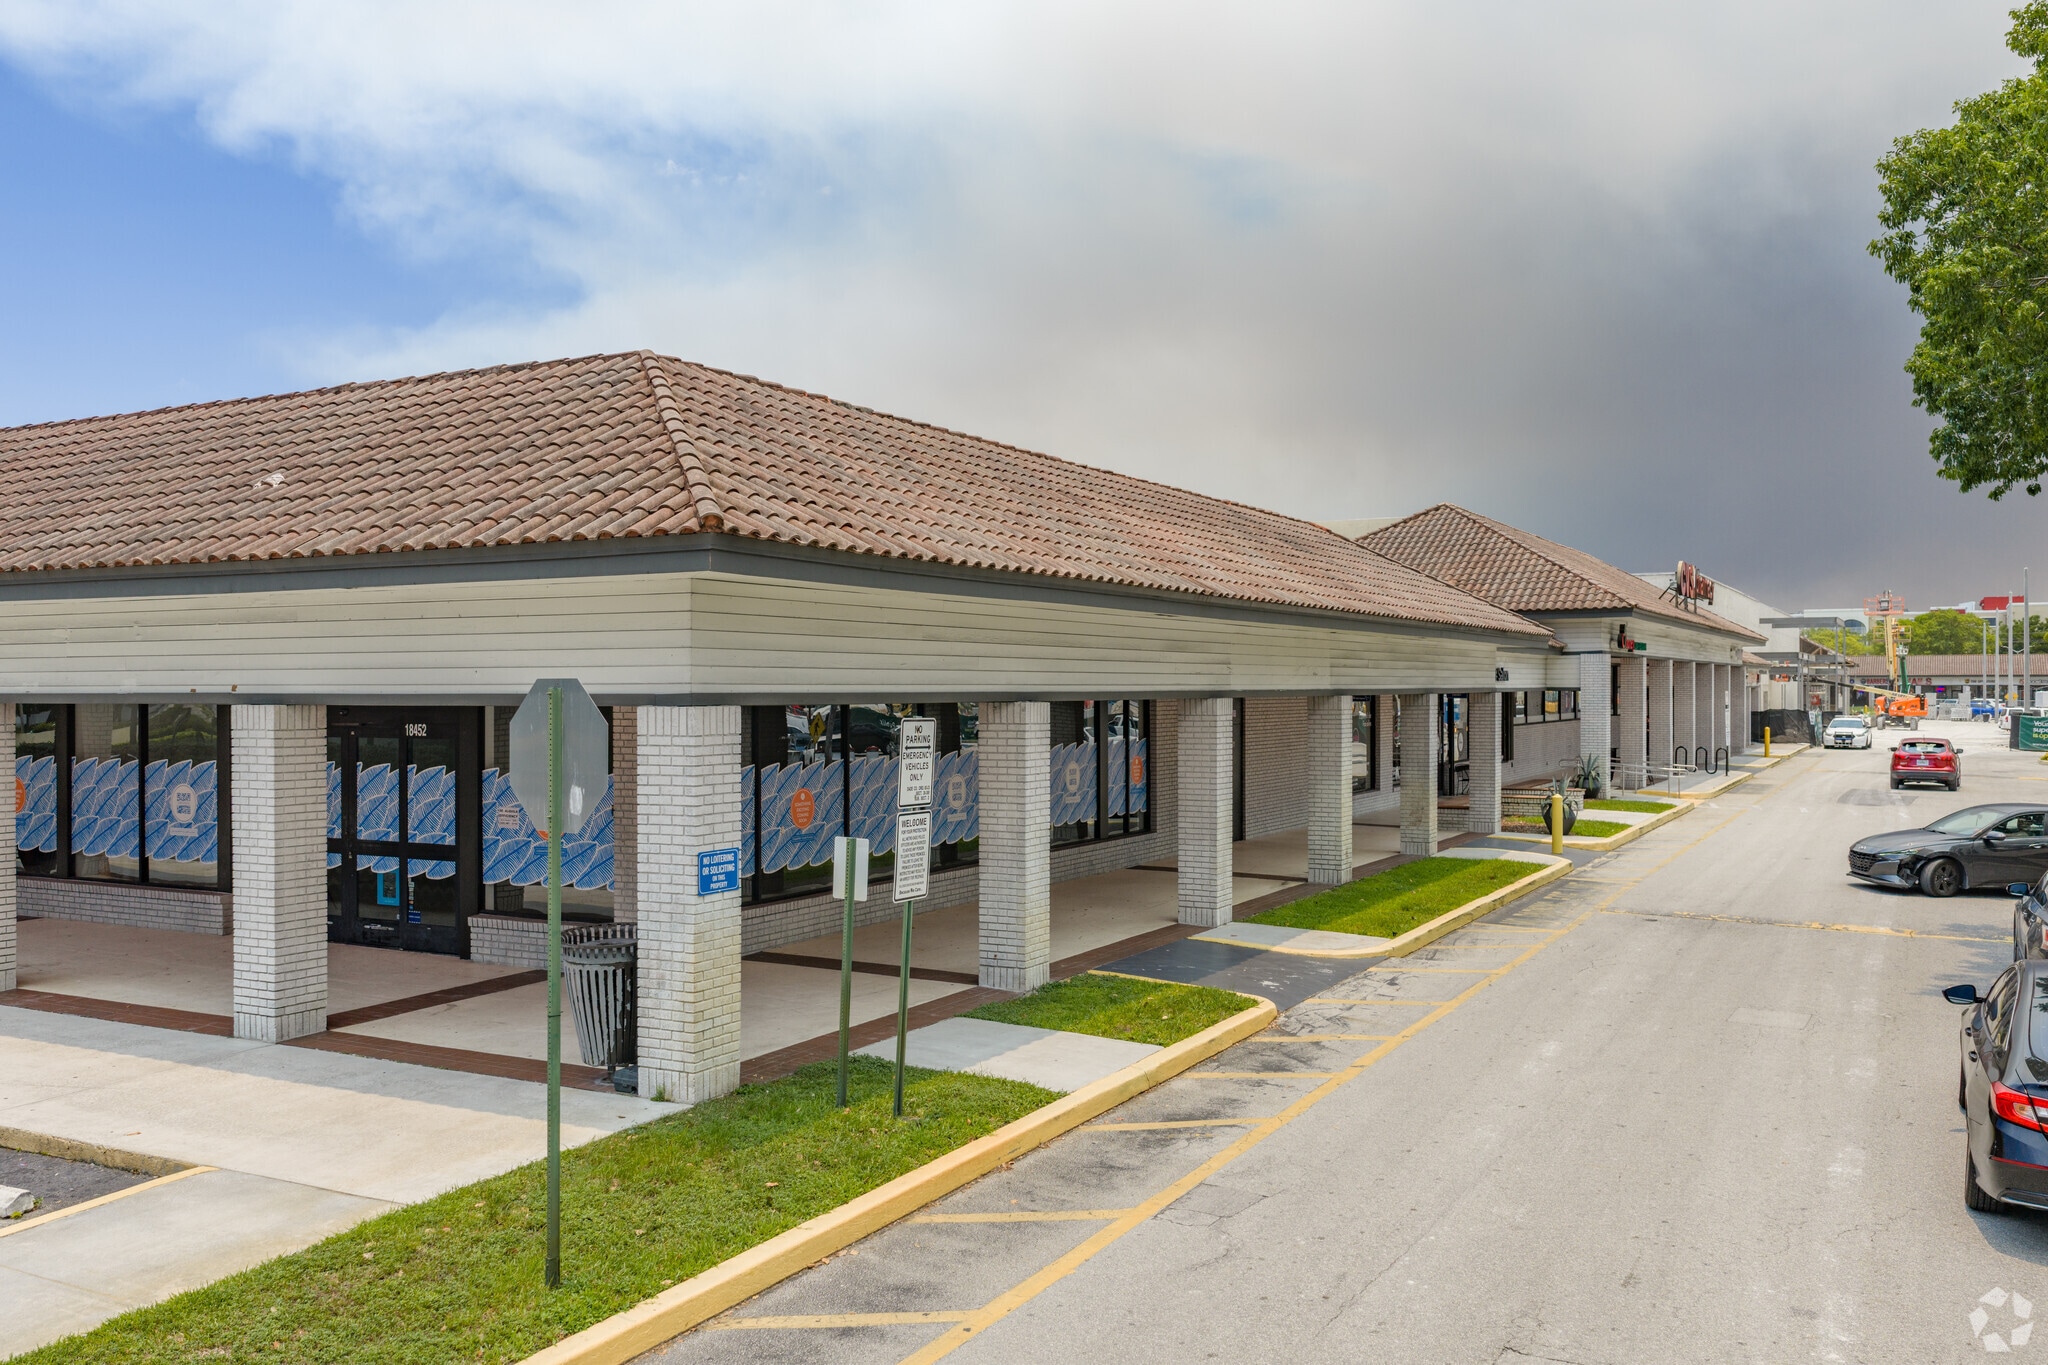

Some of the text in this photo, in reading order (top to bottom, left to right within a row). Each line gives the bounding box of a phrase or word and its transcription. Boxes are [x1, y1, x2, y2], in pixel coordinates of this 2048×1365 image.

[405, 723, 427, 737] 18452
[915, 725, 923, 734] NO
[906, 735, 931, 744] PARKING
[903, 751, 932, 760] EMERGENCY
[905, 762, 929, 771] VEHICLES
[910, 773, 923, 782] ONLY
[901, 817, 927, 828] WELCOME
[703, 853, 734, 865] NO LOITERING
[702, 863, 735, 875] OR SOLICITING
[710, 881, 728, 889] PROPERTY
